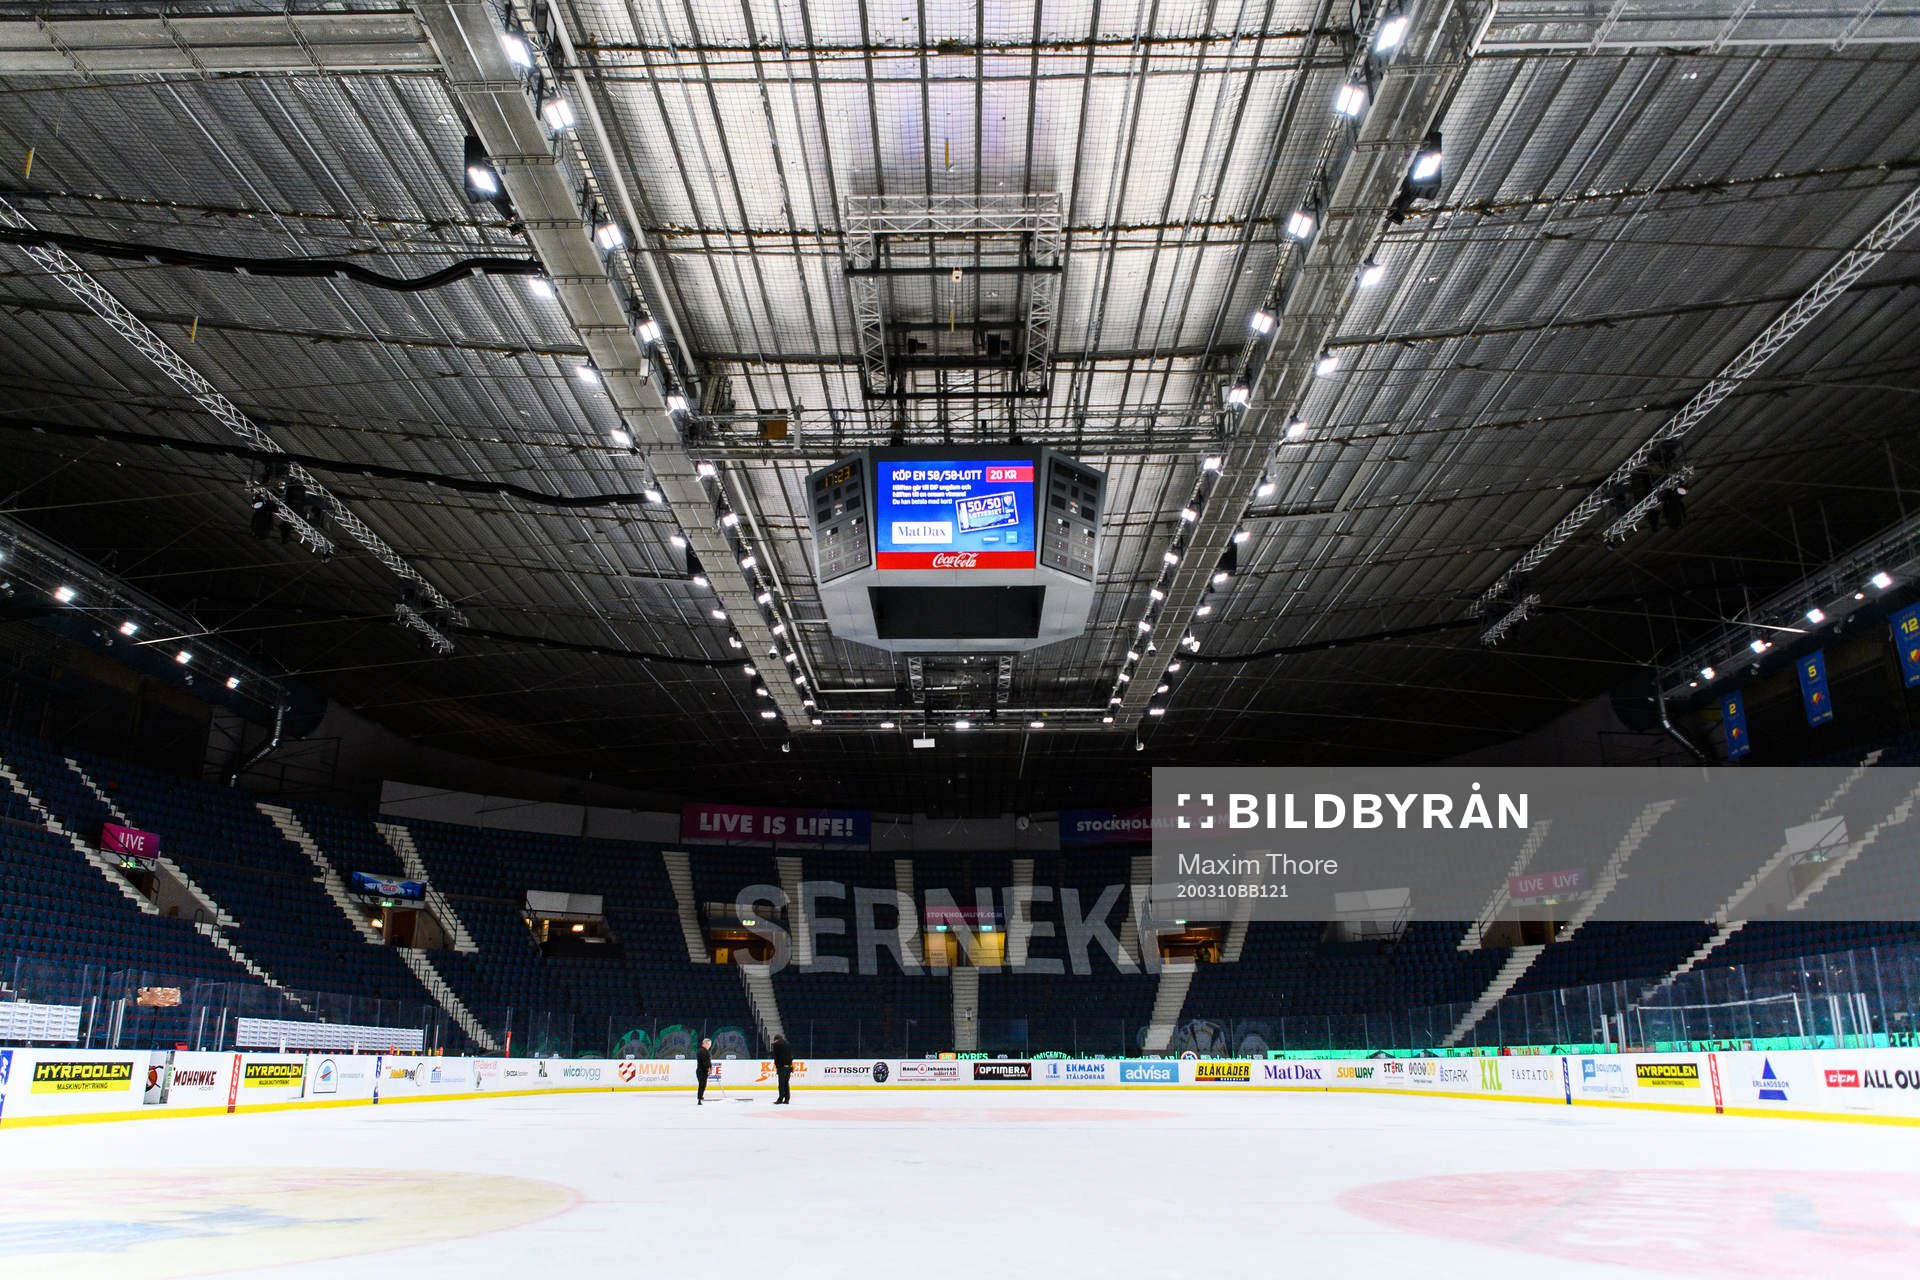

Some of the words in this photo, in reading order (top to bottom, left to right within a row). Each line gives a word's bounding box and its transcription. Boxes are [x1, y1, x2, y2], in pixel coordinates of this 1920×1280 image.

[892, 470, 911, 480] KÖP
[913, 470, 926, 480] EN
[928, 470, 982, 481] 50/50-LOTT
[990, 470, 1002, 480] 20
[1004, 470, 1017, 480] KR
[967, 497, 1001, 512] 50/50
[898, 526, 920, 537] Mat
[923, 526, 946, 537] Dax
[932, 552, 980, 568] Coca-Cola
[1901, 618, 1919, 634] 12
[1808, 665, 1817, 677] 5
[1729, 703, 1736, 714] 2
[699, 812, 753, 834] LIVE
[763, 815, 786, 835] IS
[796, 817, 854, 837] LIFE!
[119, 832, 145, 851] LIVE
[1520, 878, 1543, 892] LIVE
[1553, 873, 1578, 888] LIVE
[36, 1064, 131, 1080] HYRPOOLEN
[246, 1065, 303, 1077] HYRPOOLEN
[563, 1065, 600, 1080] wicabygg
[638, 1063, 670, 1074] MVM
[838, 1066, 870, 1074] TISSOT
[979, 1066, 1026, 1074] OPTIMERA
[1066, 1063, 1105, 1072] EKMANS
[1125, 1065, 1170, 1080] advisa
[1198, 1062, 1250, 1076] BLÅKLÄDER
[1264, 1065, 1292, 1079] Mat
[1295, 1065, 1322, 1079] Dax
[1337, 1066, 1374, 1078] SUBWAY
[1637, 1065, 1697, 1077] HYRPOOLEN
[173, 1070, 217, 1087] MOHAWKE
[1480, 1059, 1502, 1090] XXL
[1512, 1069, 1554, 1081] FASTATOR
[1828, 1074, 1856, 1083] CCM
[1864, 1069, 1893, 1088] ALL
[1895, 1069, 1920, 1090] OU
